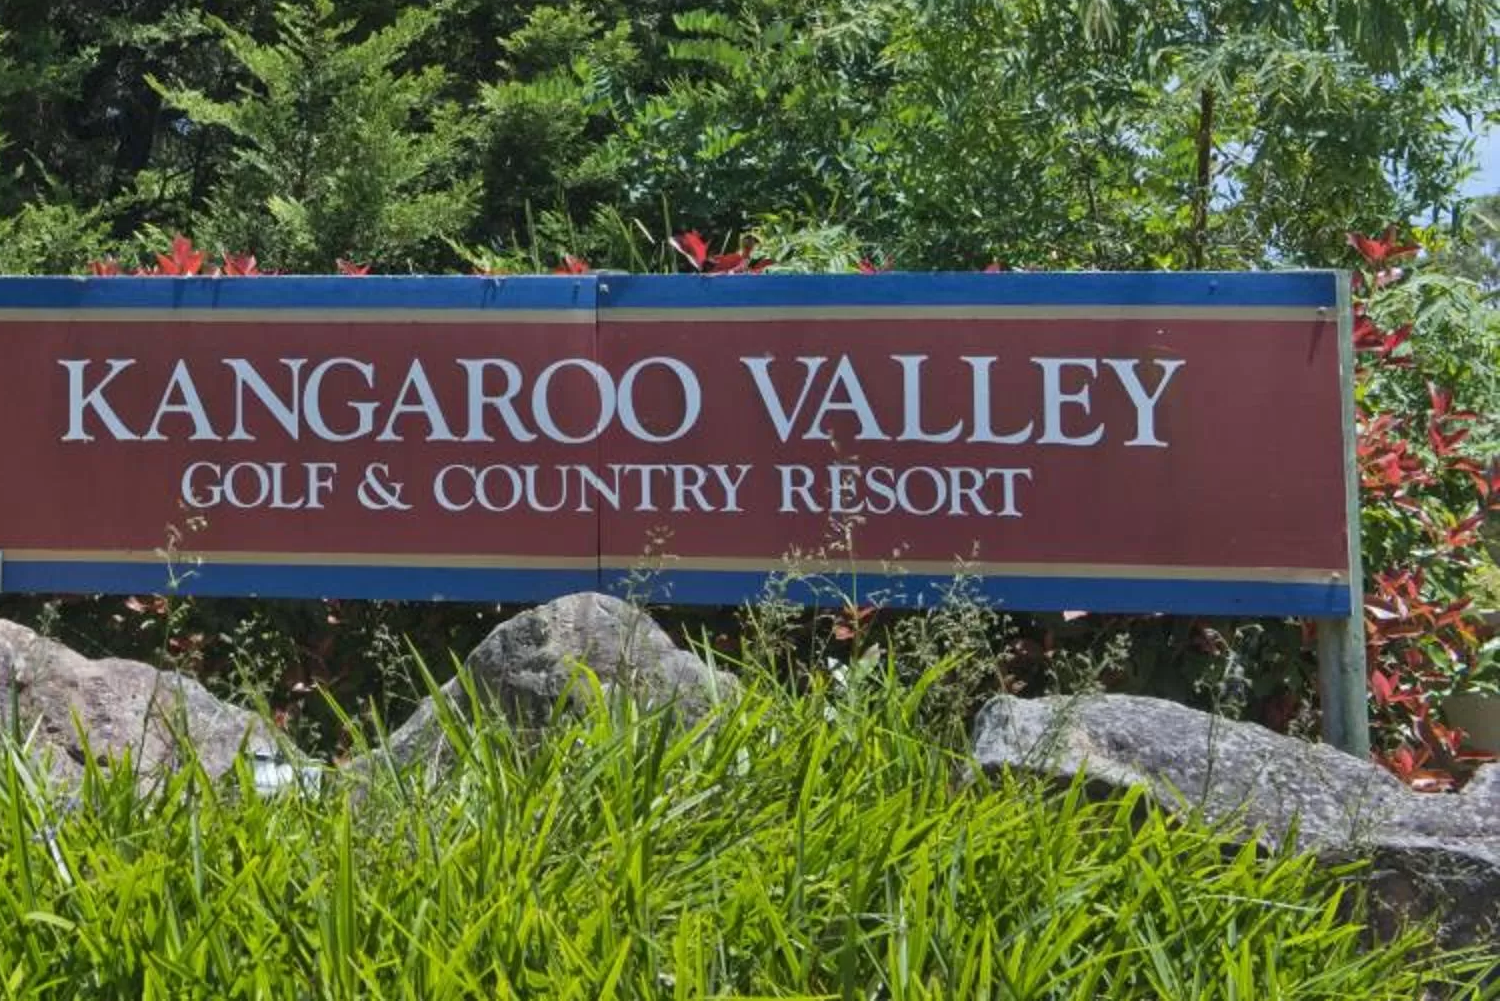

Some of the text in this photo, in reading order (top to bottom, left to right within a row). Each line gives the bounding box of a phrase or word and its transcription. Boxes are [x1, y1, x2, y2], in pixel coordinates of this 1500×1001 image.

[57, 354, 1186, 448] KANGAROO VALLEY
[181, 461, 1033, 518] GOLF & COUNTRY RESORT
